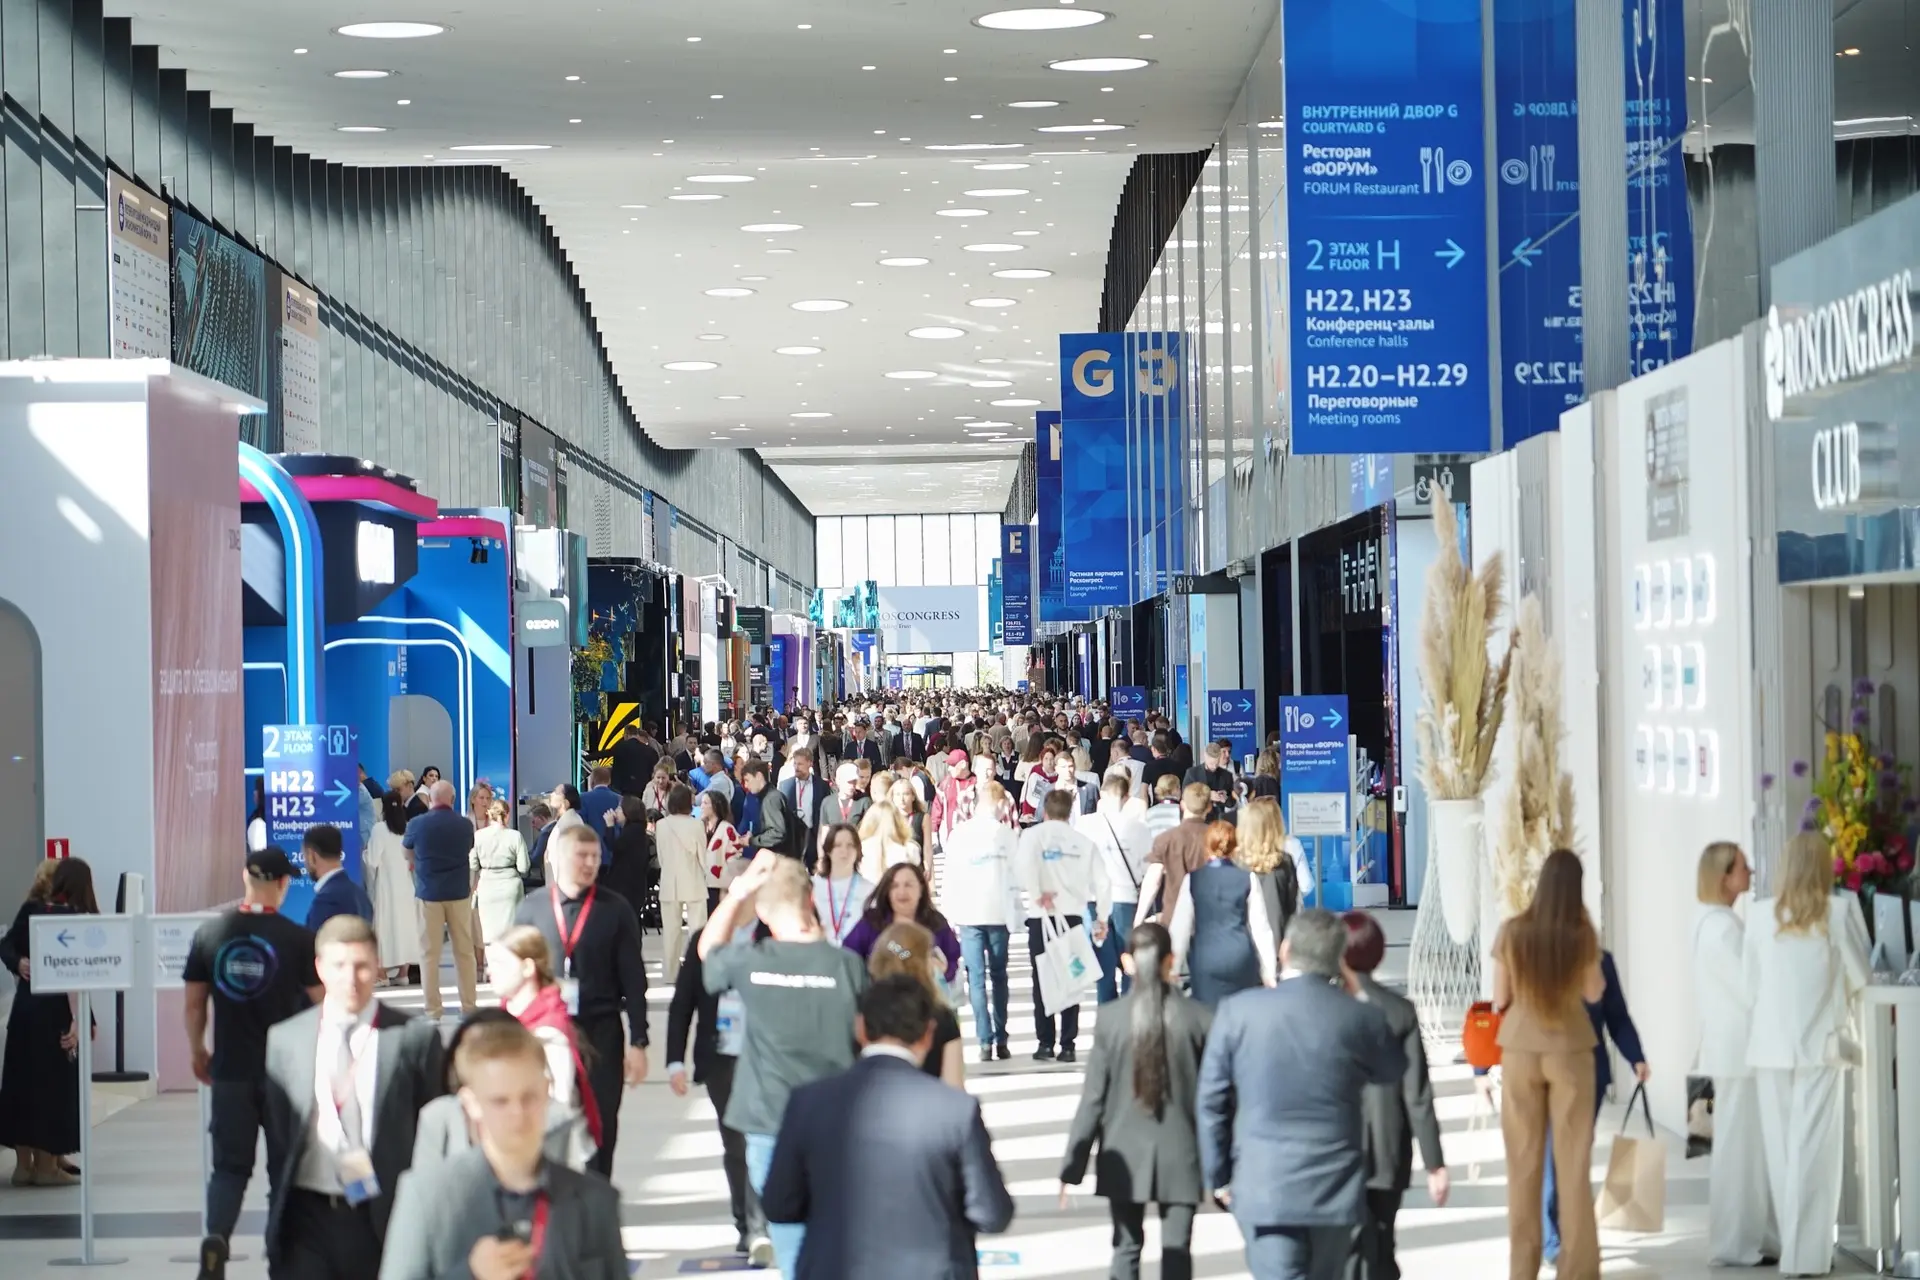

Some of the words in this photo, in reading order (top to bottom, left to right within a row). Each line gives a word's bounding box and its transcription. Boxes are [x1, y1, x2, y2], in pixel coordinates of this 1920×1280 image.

[1302, 103, 1399, 119] ВНУТРЕННИЙ
[1403, 104, 1444, 119] ДВОР
[1448, 104, 1458, 117] G
[1302, 122, 1373, 134] COURTYARD
[1377, 122, 1386, 133] G
[1302, 144, 1371, 160] Ресторан
[1303, 161, 1378, 176] «ФОРУМ»
[1303, 182, 1351, 194] FORUM
[1354, 182, 1419, 194] Restaurant
[1306, 239, 1324, 271] 2
[1328, 242, 1370, 256] ЭТАЖ
[1377, 239, 1400, 271] H
[1329, 258, 1370, 271] FLOOR
[1305, 288, 1360, 313] H22,
[1363, 288, 1412, 312] H23
[1306, 316, 1435, 334] Конференц-залы
[1784, 267, 1914, 398] ROSCONGRESS
[1306, 334, 1375, 348] Conference
[1379, 334, 1408, 348] halls
[1072, 350, 1114, 397] G
[1308, 393, 1418, 411] Переговорные
[1308, 412, 1359, 428] Meeting
[1362, 413, 1401, 425] rooms
[1812, 421, 1861, 510] CLUB
[1009, 531, 1022, 554] E
[263, 726, 280, 758] 2
[284, 730, 312, 742] ЭТАЖ
[284, 743, 314, 754] FLOOR
[271, 770, 314, 793] H22
[272, 797, 315, 817] H23
[43, 955, 121, 968] Пресс-центр
